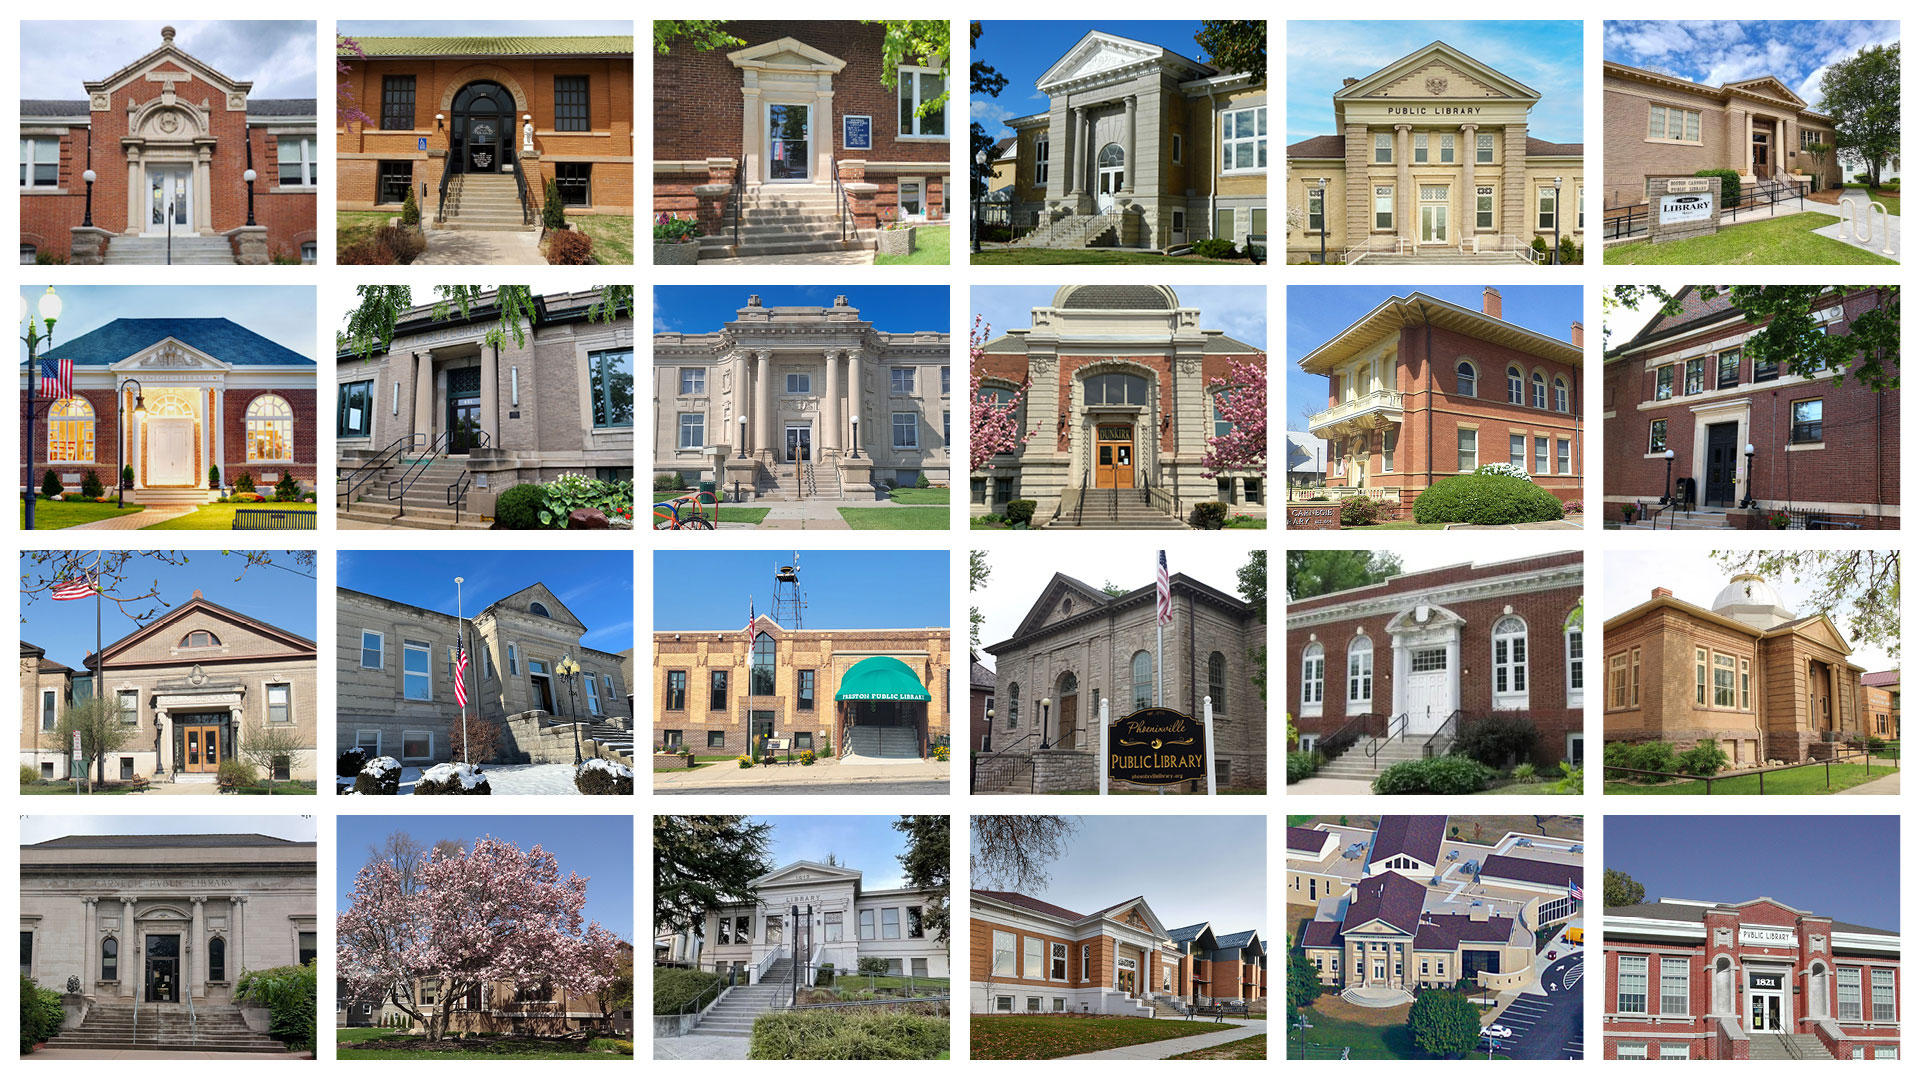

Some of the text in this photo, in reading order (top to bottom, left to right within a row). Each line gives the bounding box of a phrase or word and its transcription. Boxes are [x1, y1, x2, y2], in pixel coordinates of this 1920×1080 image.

[1388, 107, 1481, 115] PUBLIC LIBRARY
[1663, 201, 1710, 213] LIBRARY
[416, 322, 492, 343] PUBLIC LIBRARY
[1099, 429, 1130, 440] DUNKIRK
[1291, 509, 1334, 517] CARNEGIE
[1126, 719, 1186, 735] Phoenixville
[1111, 752, 1202, 769] PUBLIC LIBRARY
[94, 880, 143, 888] CARNEGIE
[191, 879, 233, 887] LIBRARY
[786, 895, 821, 903] LIBRARY
[1766, 932, 1789, 941] LIBRARY
[1755, 978, 1775, 986] 1821
